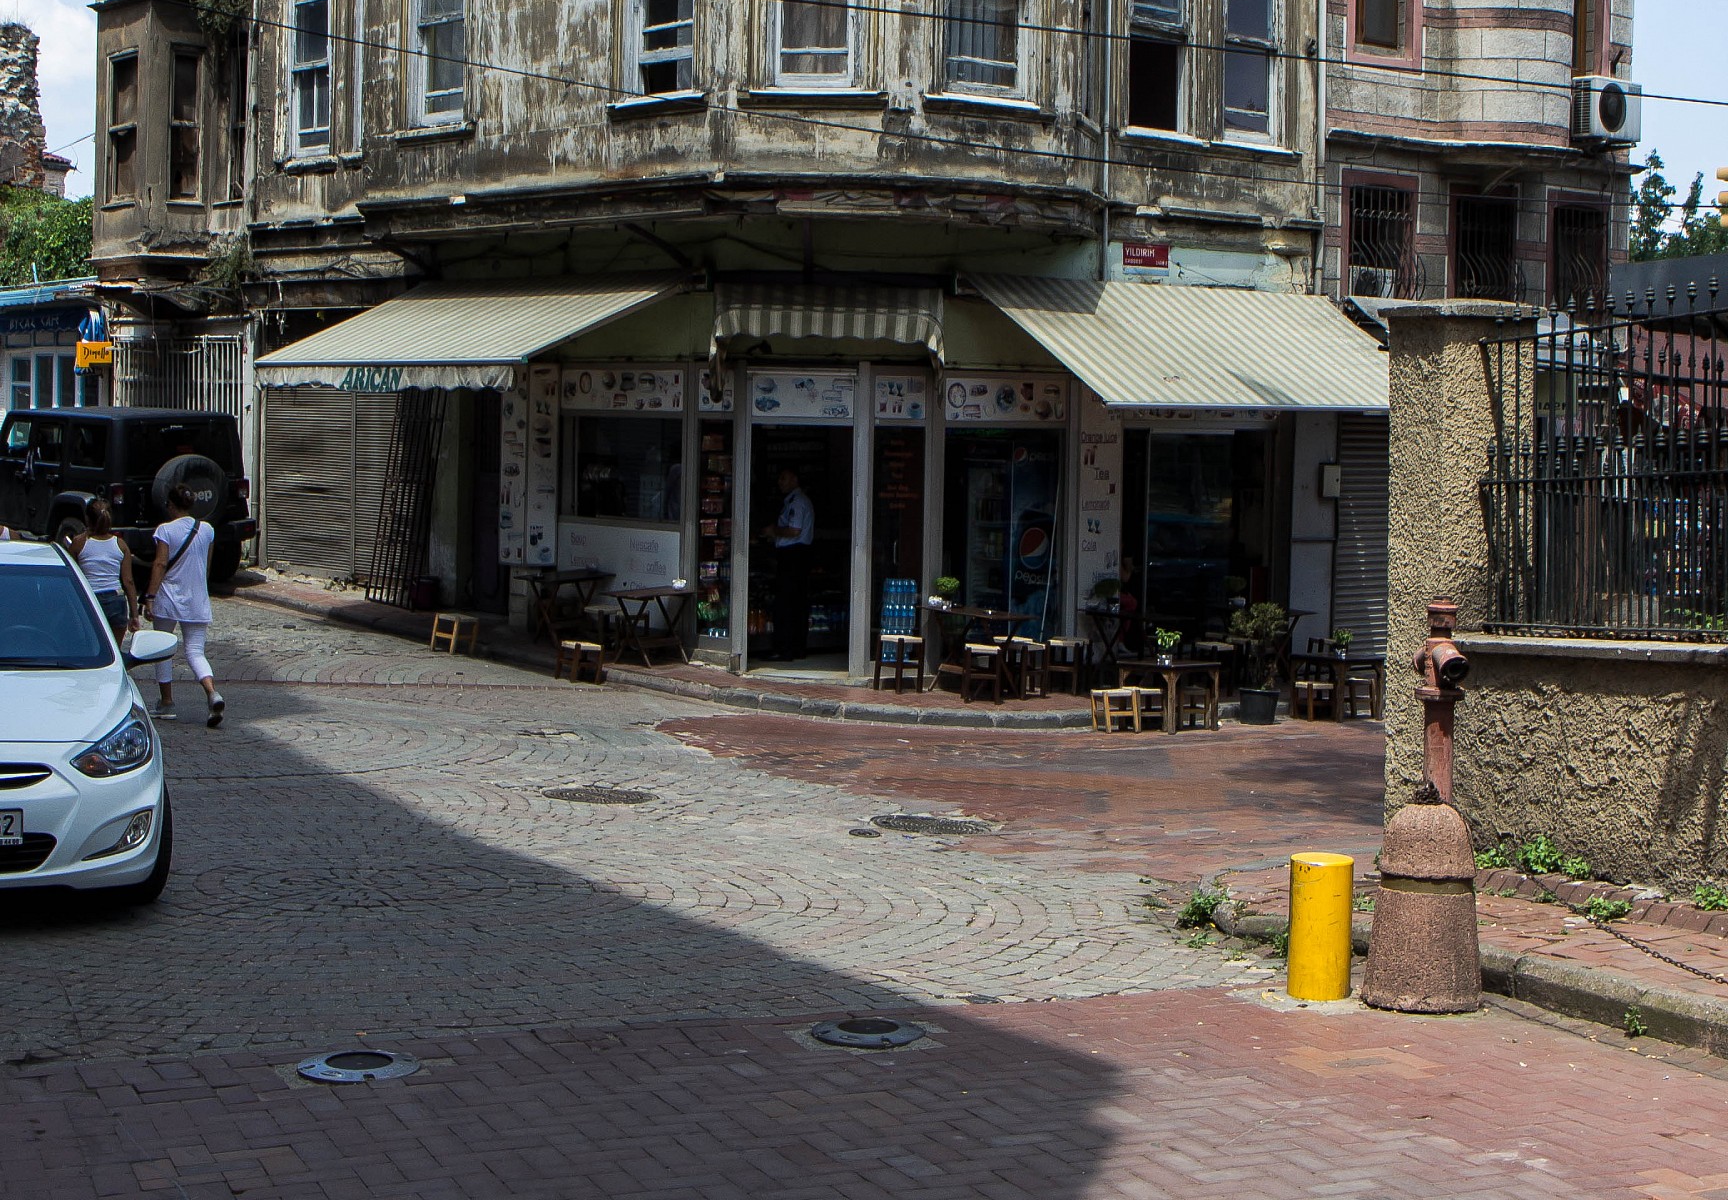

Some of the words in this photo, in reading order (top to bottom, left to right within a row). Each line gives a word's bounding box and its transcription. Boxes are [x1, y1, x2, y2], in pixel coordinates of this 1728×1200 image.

[1125, 247, 1155, 258] YILDIRIM
[339, 367, 403, 392] ARICAN
[1094, 468, 1109, 480] Tea
